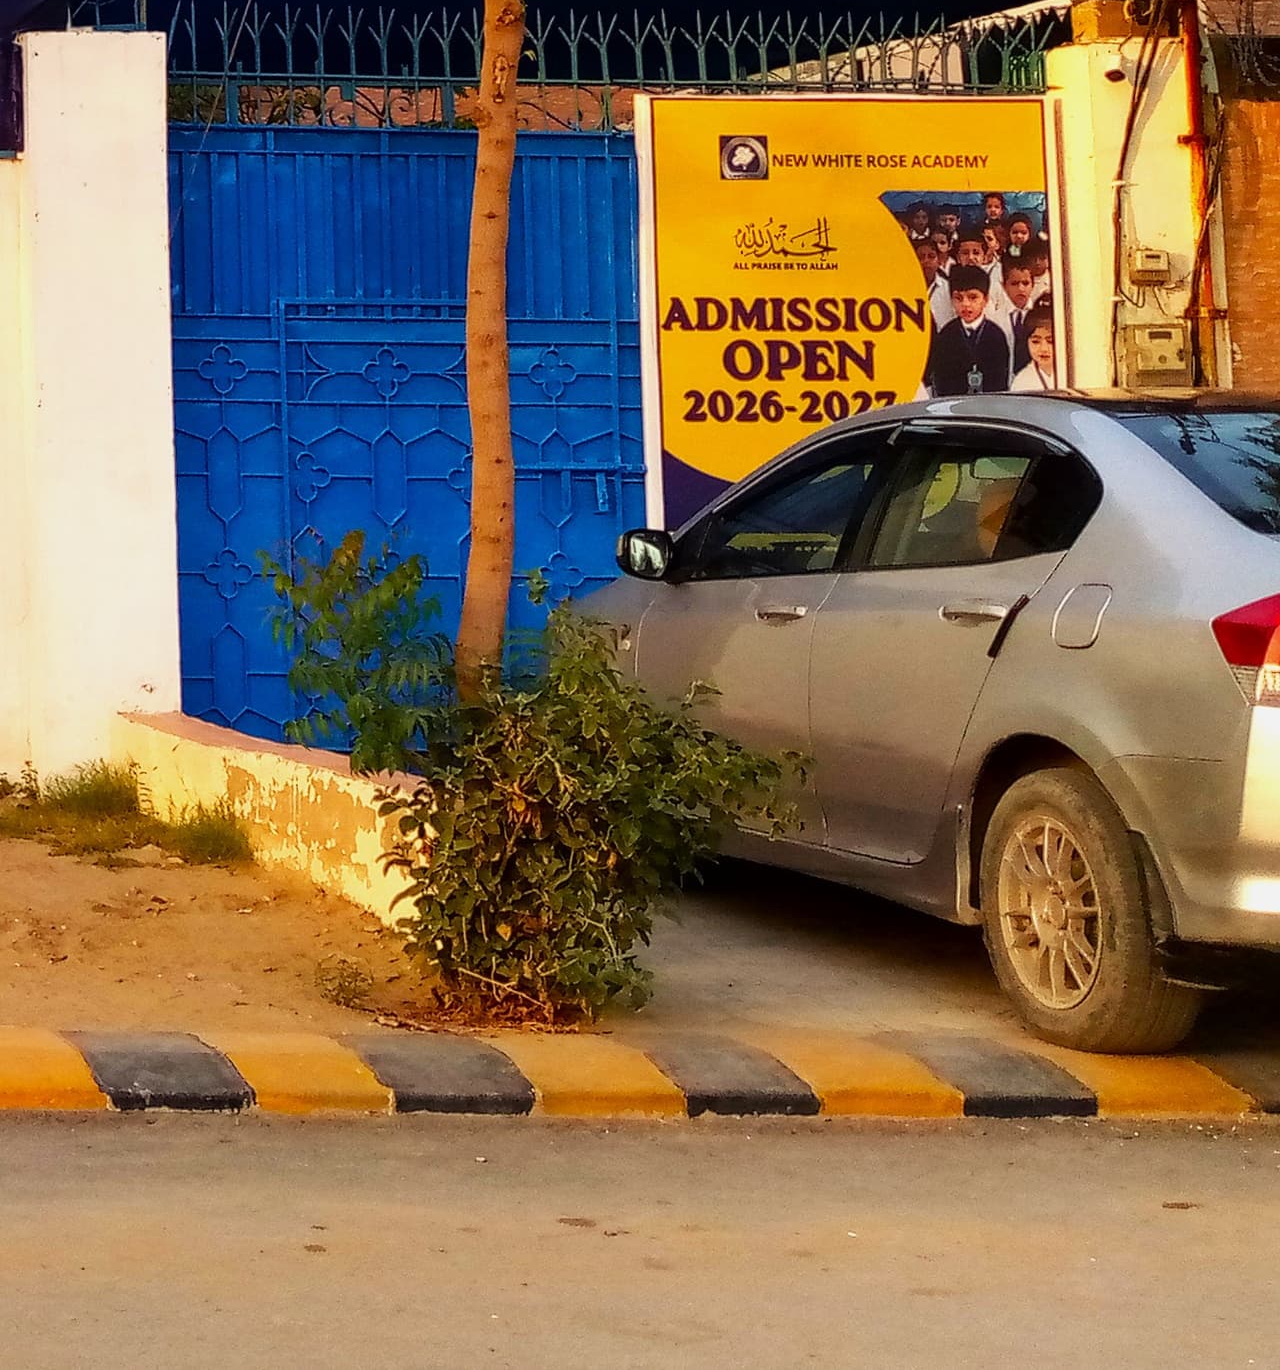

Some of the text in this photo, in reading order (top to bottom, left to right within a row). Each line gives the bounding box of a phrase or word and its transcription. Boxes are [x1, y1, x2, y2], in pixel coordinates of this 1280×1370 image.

[772, 154, 989, 169] NEW WHITE ROSE ACADEMY
[733, 262, 749, 270] ALL
[751, 262, 781, 270] PRAISE
[796, 262, 808, 270] TO
[810, 262, 838, 270] ALLAH
[662, 297, 925, 332] ADMISSION
[723, 339, 874, 382] OPEN
